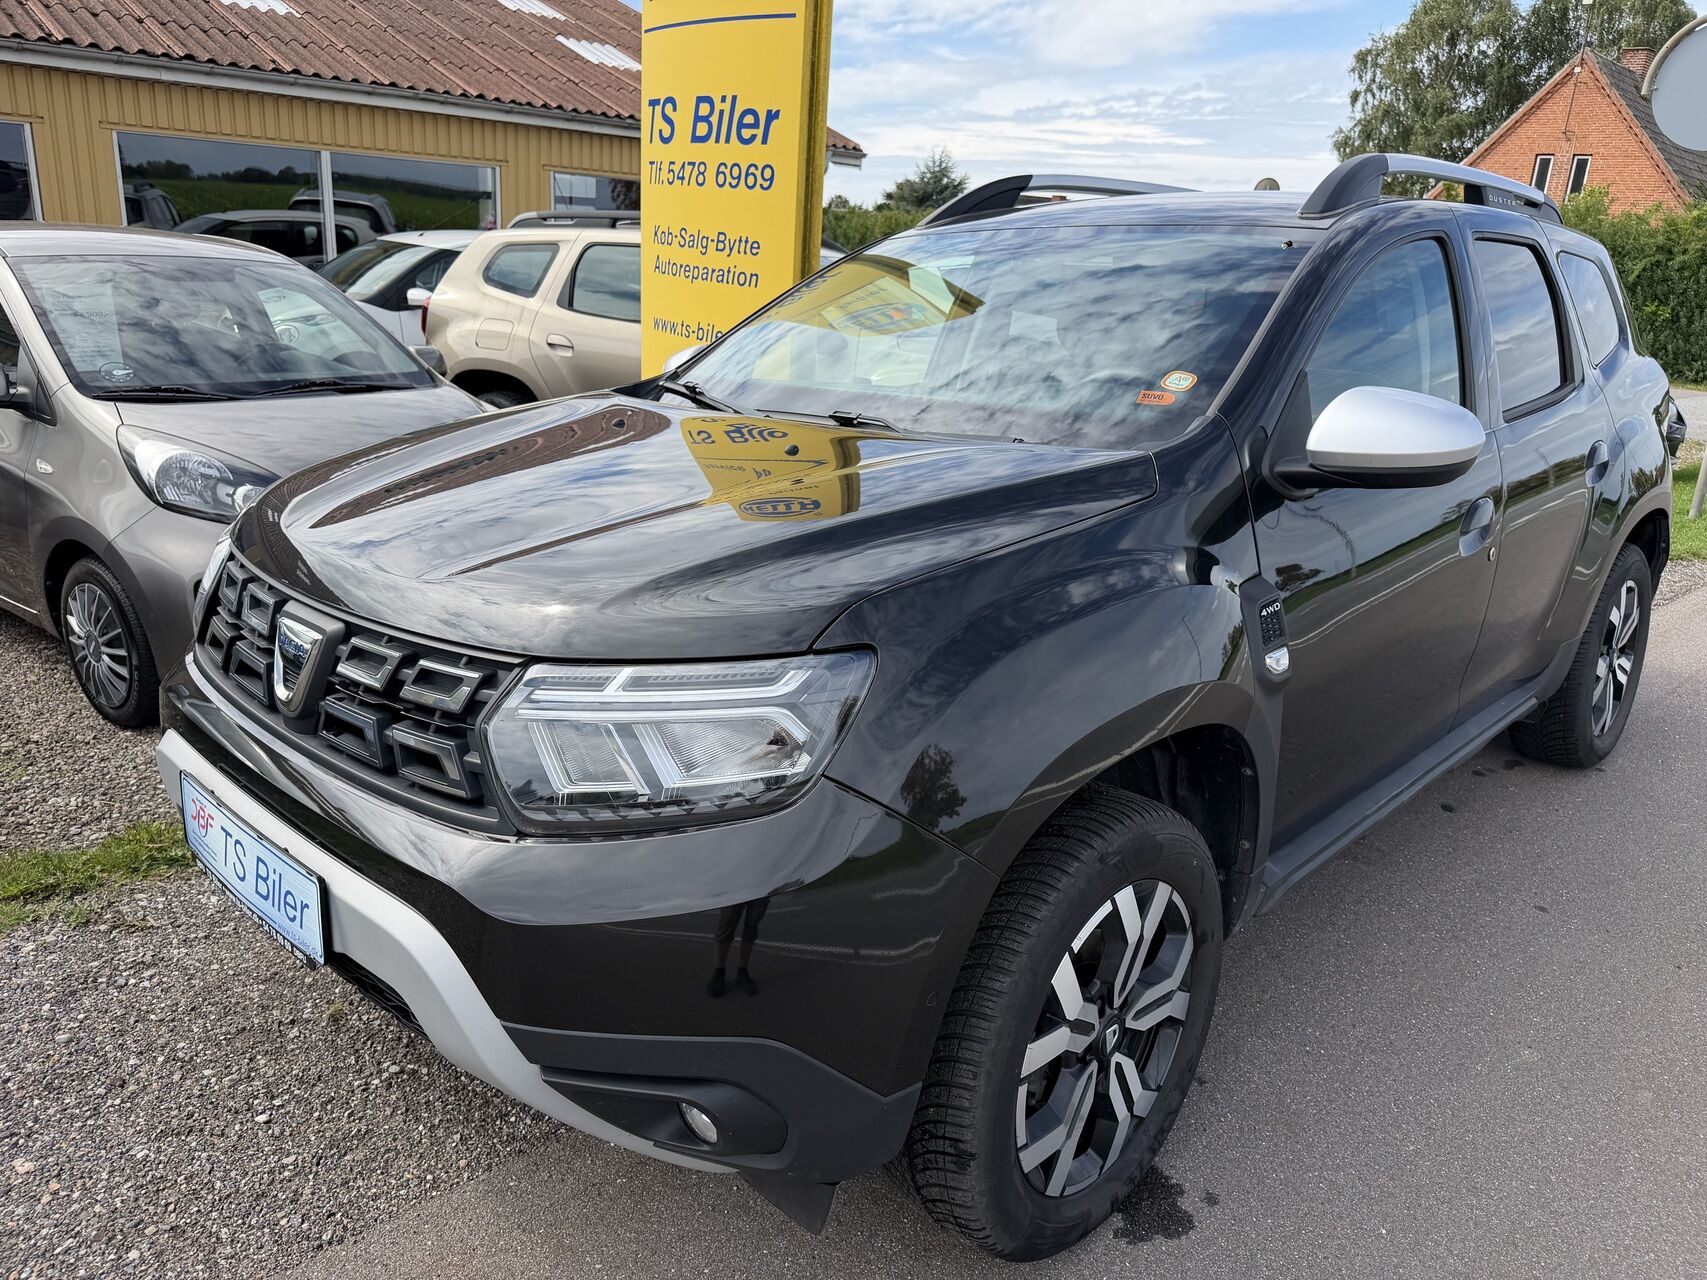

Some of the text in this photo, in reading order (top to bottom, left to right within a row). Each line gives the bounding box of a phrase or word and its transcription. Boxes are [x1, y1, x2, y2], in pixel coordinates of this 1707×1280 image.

[647, 94, 781, 146] TS Biler
[715, 162, 775, 191] 6969
[1488, 194, 1516, 207] DUSTER
[653, 254, 759, 288] Autoreparation
[1141, 392, 1164, 401] SUVO
[1260, 602, 1281, 617] 4WD
[220, 825, 247, 883] TS
[255, 854, 311, 930] Biler
